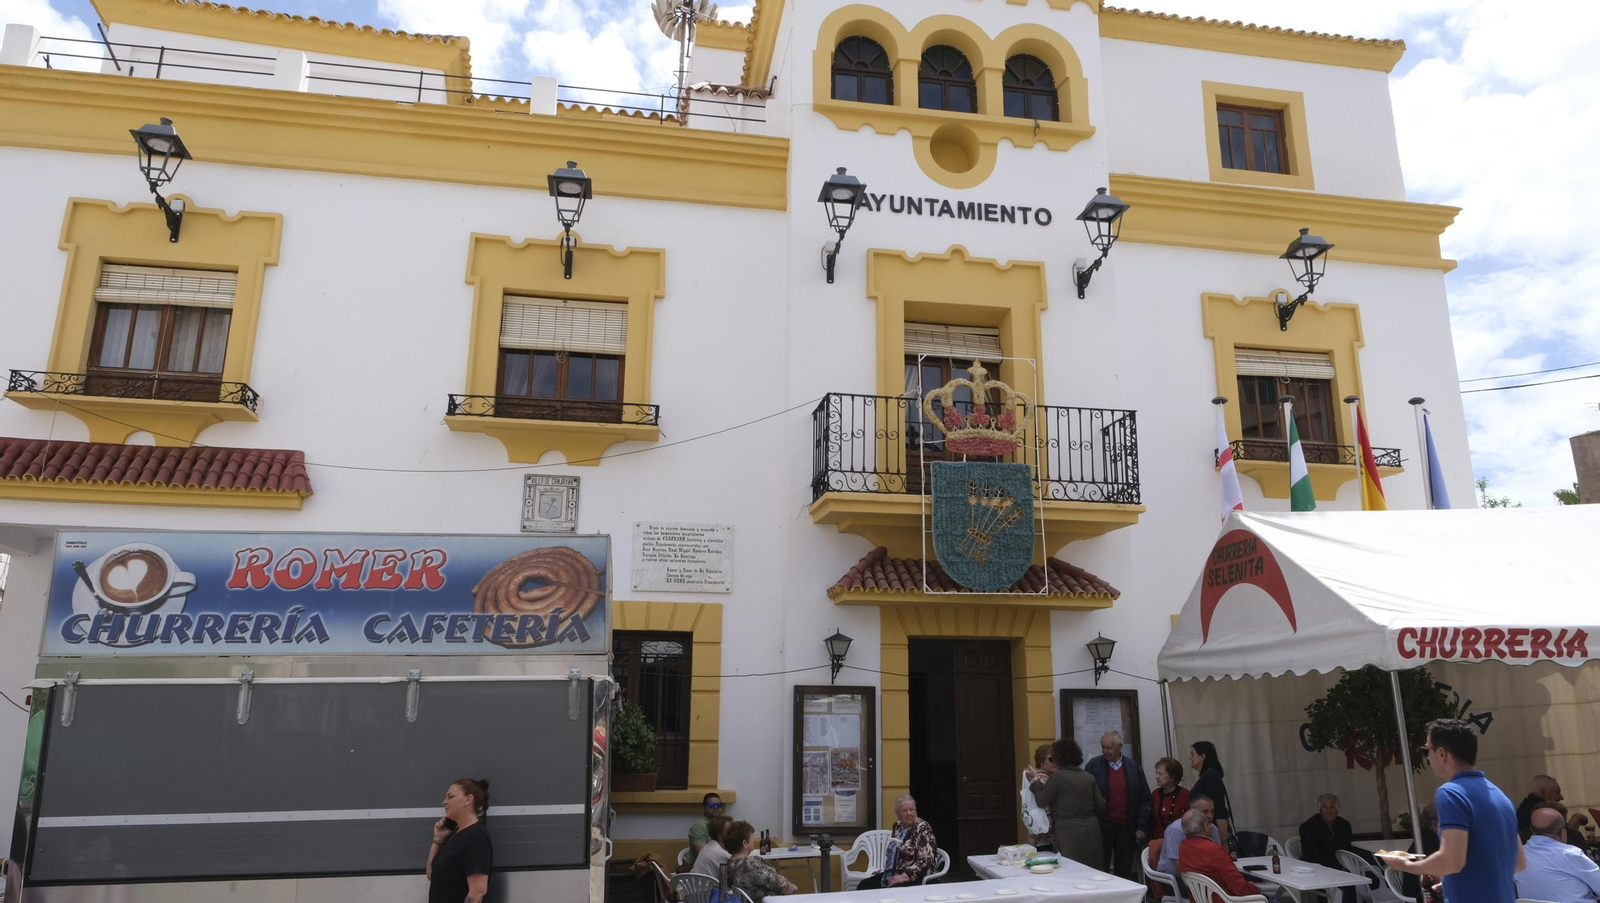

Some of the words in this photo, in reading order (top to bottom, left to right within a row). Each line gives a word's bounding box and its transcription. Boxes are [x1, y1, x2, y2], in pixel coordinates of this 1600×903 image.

[856, 193, 1053, 226] AYUNTAMIENTO
[1212, 536, 1258, 565] CHURRERIA
[227, 547, 447, 592] ROMER
[1207, 555, 1265, 588] SELENITA
[61, 605, 331, 646] CHURRERÍA
[363, 605, 592, 645] CAFETERÍA
[1396, 626, 1589, 660] CHURRERIA
